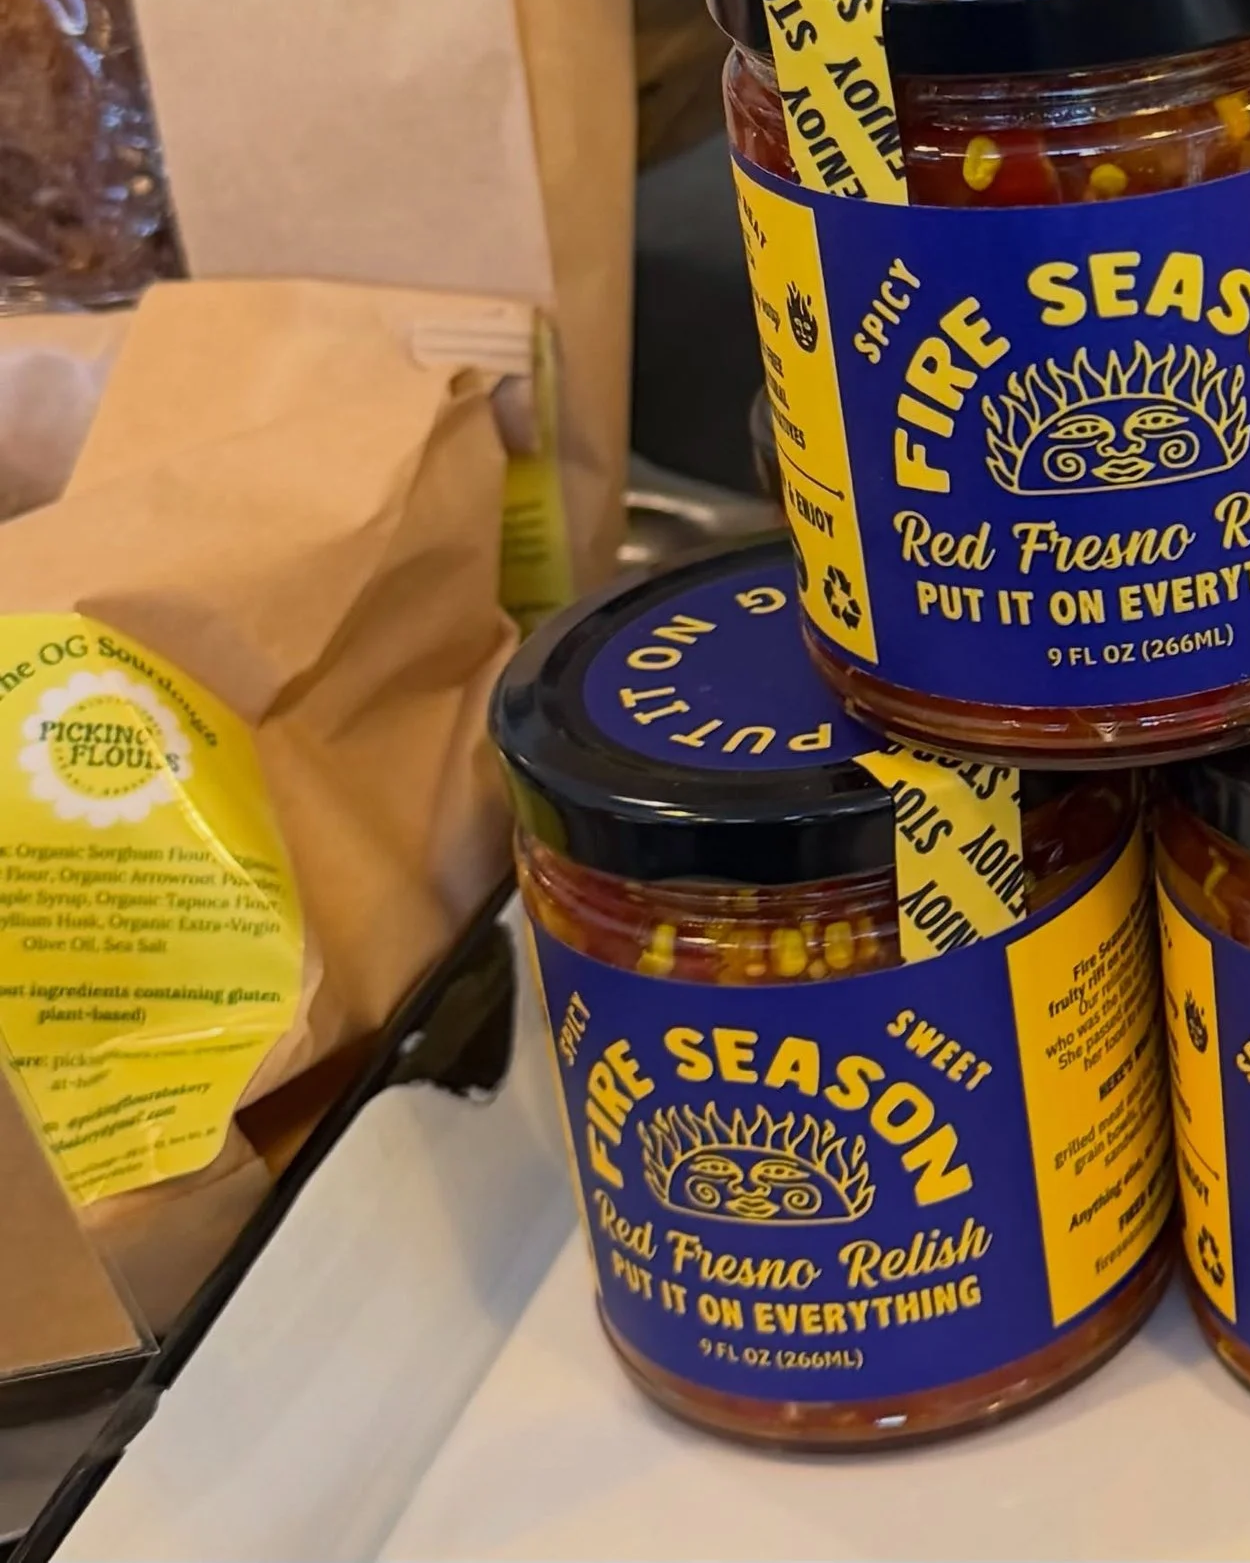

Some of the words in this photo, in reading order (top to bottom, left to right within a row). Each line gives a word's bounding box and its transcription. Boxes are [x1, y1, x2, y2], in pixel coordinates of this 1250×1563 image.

[854, 256, 922, 365] SPICY
[894, 295, 1012, 494] FIRE
[892, 510, 997, 573] Red
[1011, 520, 1197, 576] Fresno
[916, 584, 985, 624] PUT
[998, 589, 1034, 627] IT
[1050, 585, 1107, 627] ON
[0, 660, 36, 700] he
[38, 634, 89, 666] OG
[626, 613, 718, 671] ON
[1047, 646, 1063, 668] 9
[1068, 643, 1097, 667] FL
[1103, 641, 1137, 664] OZ
[1141, 622, 1235, 661] (266ML)
[617, 685, 692, 726] IT
[671, 718, 832, 755] PUT
[898, 879, 982, 952] NJOY
[557, 990, 591, 1067] SPICY
[886, 1008, 993, 1092] SWEET
[586, 1038, 656, 1189] FIRE
[662, 1026, 973, 1207] SEASON
[593, 1190, 658, 1258] Red
[665, 1229, 821, 1291] Fresno
[837, 1216, 994, 1289] Relish
[610, 1252, 653, 1300] PUT
[662, 1281, 688, 1316] IT
[697, 1294, 744, 1331] ON
[754, 1274, 983, 1335] EVERYTHING
[716, 1341, 739, 1361] FL
[741, 1346, 772, 1367] OZ
[776, 1347, 864, 1370] (266ML)
